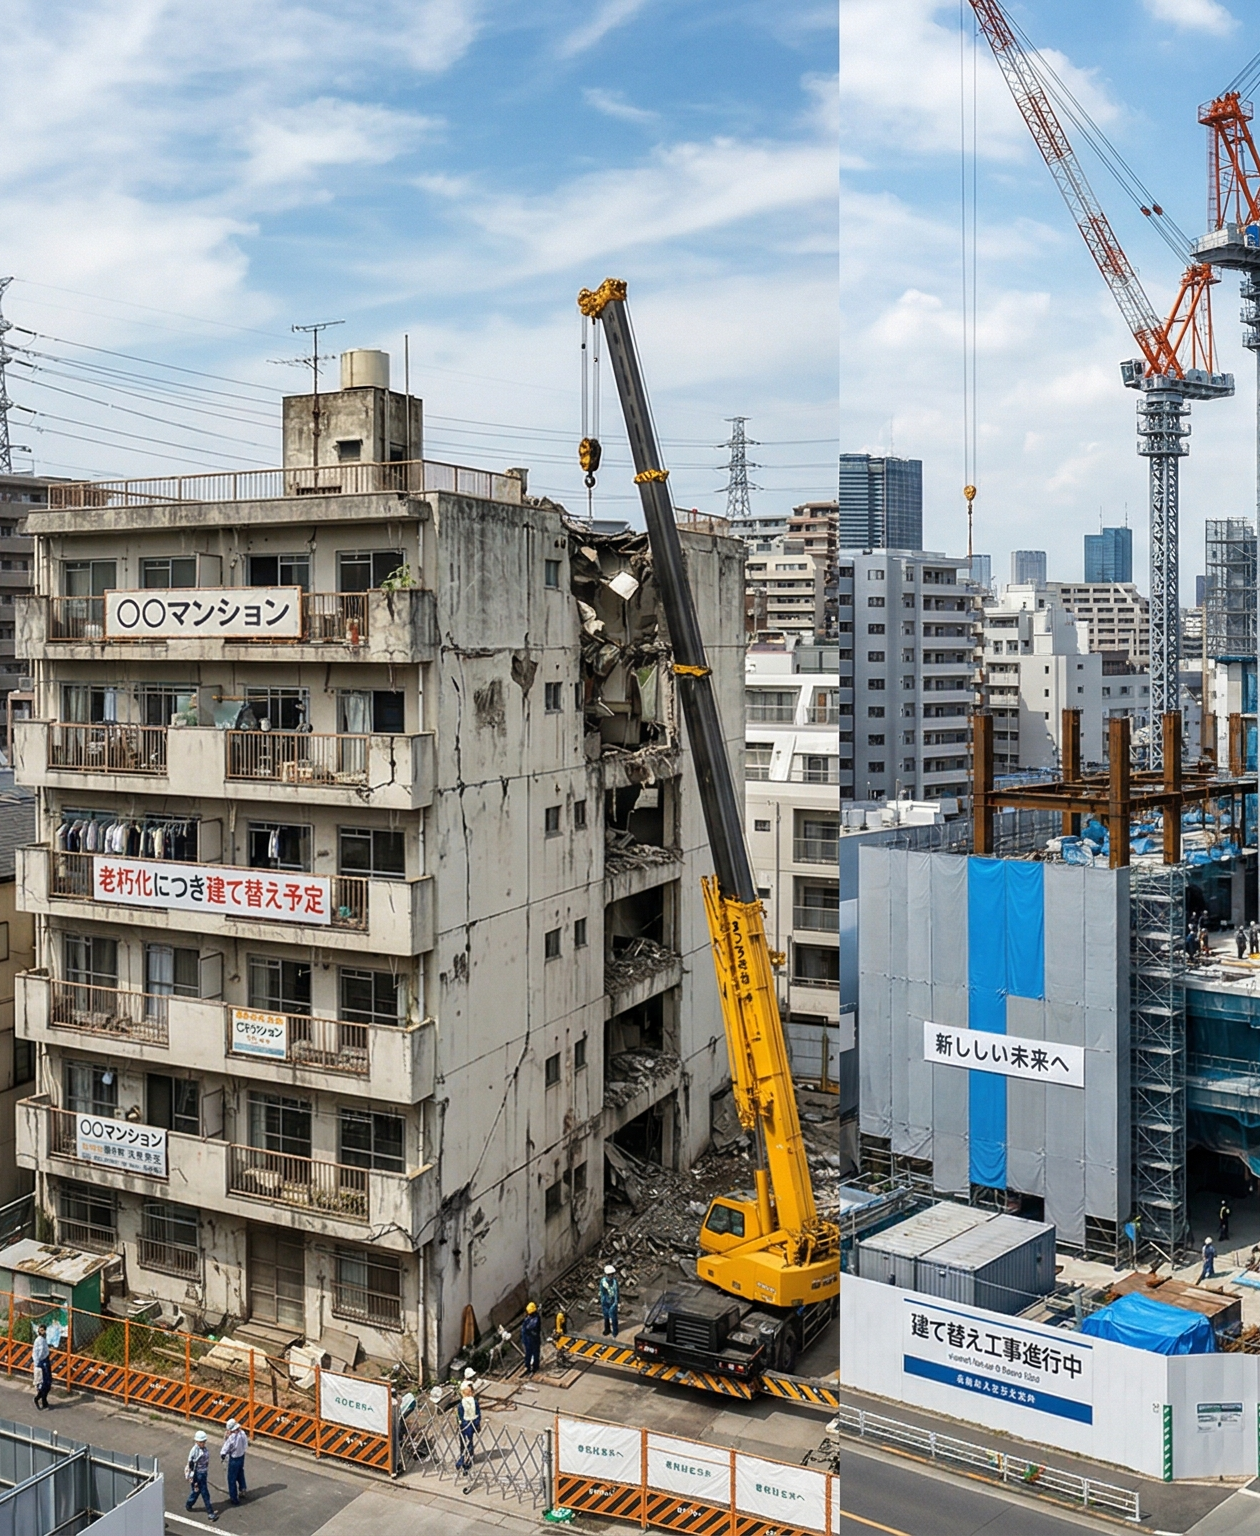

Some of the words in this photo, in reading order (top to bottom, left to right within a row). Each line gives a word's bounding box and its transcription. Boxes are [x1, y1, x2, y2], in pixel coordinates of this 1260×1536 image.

[99, 866, 324, 914] 老朽化につき建て替え予定
[935, 1032, 1069, 1072] 新ししい未来へ
[911, 1313, 1082, 1379] 建て替え工事進行中
